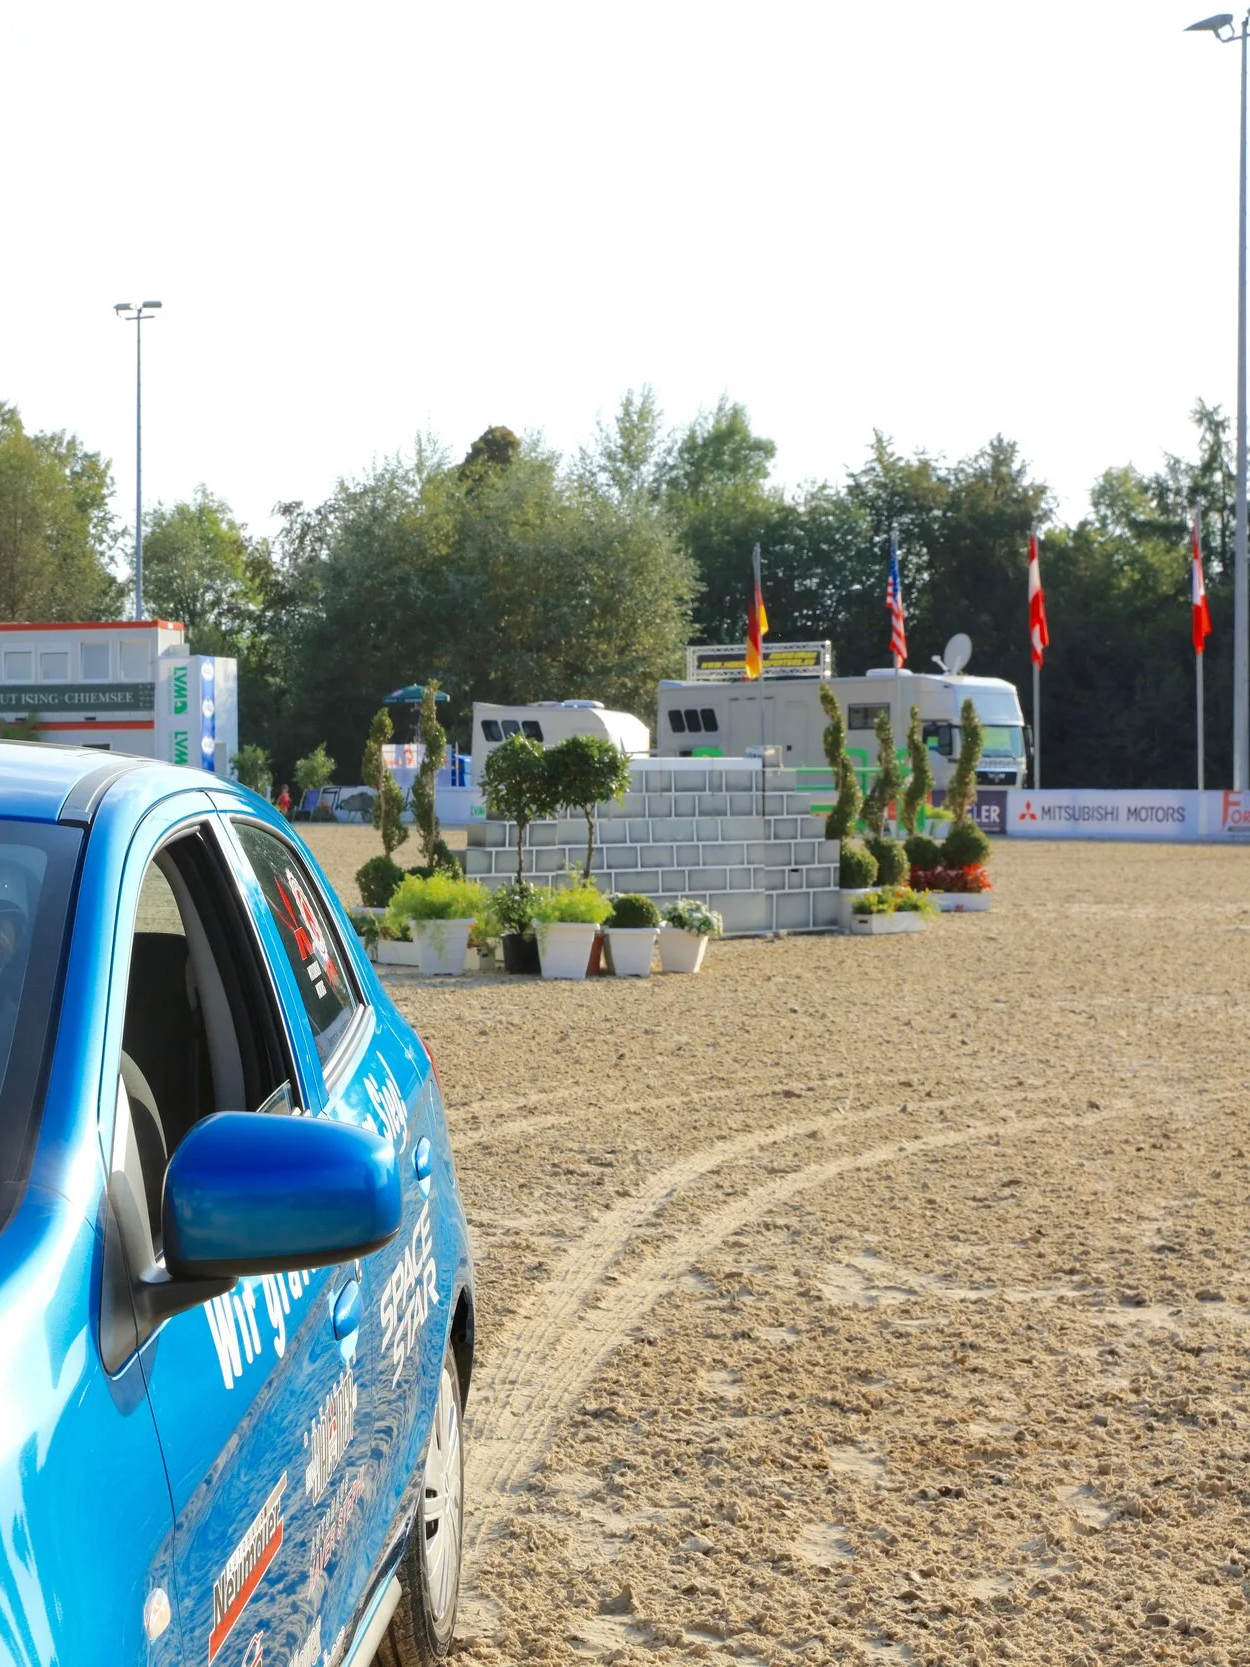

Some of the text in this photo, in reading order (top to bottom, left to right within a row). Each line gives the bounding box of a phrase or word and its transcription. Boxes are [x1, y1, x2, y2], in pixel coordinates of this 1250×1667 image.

[21, 693, 59, 705] ISING
[64, 691, 135, 704] CHIEMSEE
[174, 666, 187, 698] LVM
[1041, 805, 1185, 823] MITSUBISHI MOTORS
[380, 1199, 432, 1354] SPACE
[392, 1256, 440, 1391] STAR
